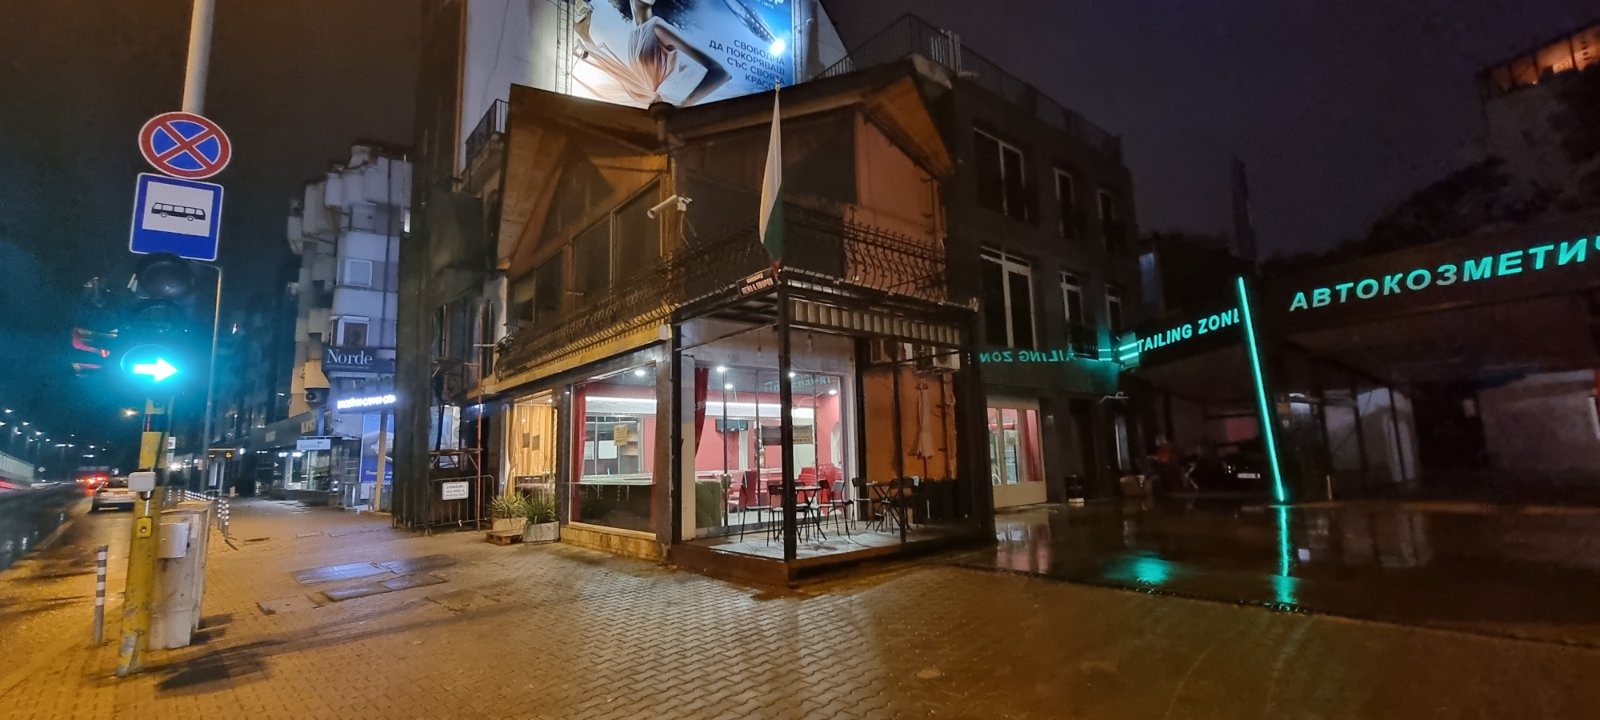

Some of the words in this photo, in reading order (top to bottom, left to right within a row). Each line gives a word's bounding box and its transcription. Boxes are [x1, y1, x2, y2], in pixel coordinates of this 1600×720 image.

[709, 40, 724, 52] ДА
[726, 46, 785, 76] ПОКОРЯВАШ
[727, 57, 748, 71] СЪС
[745, 73, 775, 89] КРАСО
[1137, 324, 1192, 353] TAILING
[326, 349, 373, 365] Norde
